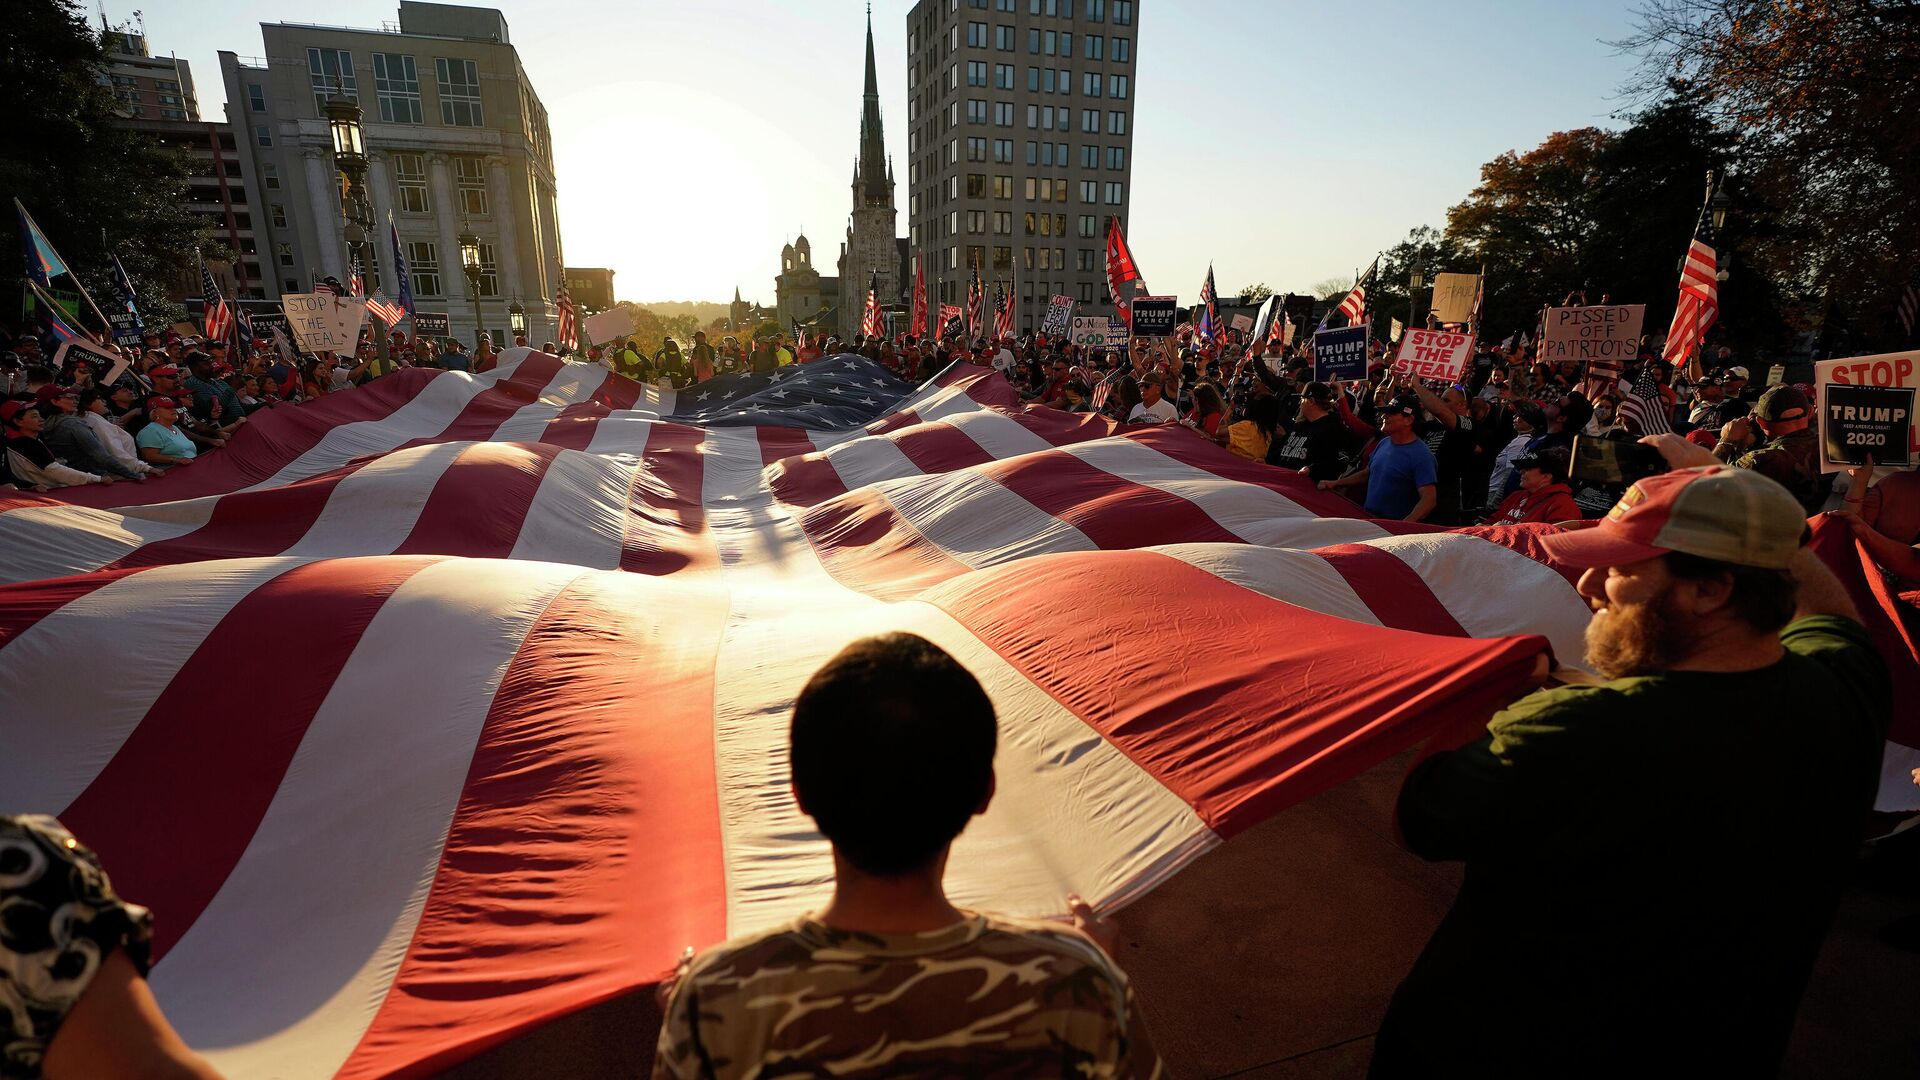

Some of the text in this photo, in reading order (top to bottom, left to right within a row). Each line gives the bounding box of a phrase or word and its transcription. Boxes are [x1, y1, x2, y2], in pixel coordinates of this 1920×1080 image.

[1445, 285, 1474, 297] FRAUD
[287, 296, 327, 312] STOP
[1134, 309, 1174, 318] TRUMP
[1560, 307, 1630, 326] PISSED
[296, 316, 326, 331] THE
[1580, 324, 1616, 338] OFF
[118, 335, 142, 346] BLUE
[1076, 333, 1104, 345] GOD
[1411, 331, 1465, 349] STOP
[1317, 340, 1365, 356] TRUMP
[1414, 346, 1454, 364] THE
[1547, 338, 1637, 358] PATRIOTS
[74, 350, 106, 365] TRUMP
[1321, 353, 1360, 364] PENCE
[1396, 358, 1457, 380] STEAL
[1831, 358, 1913, 388] STOP
[1830, 405, 1906, 423] TRUMP
[1846, 431, 1886, 446] 2020
